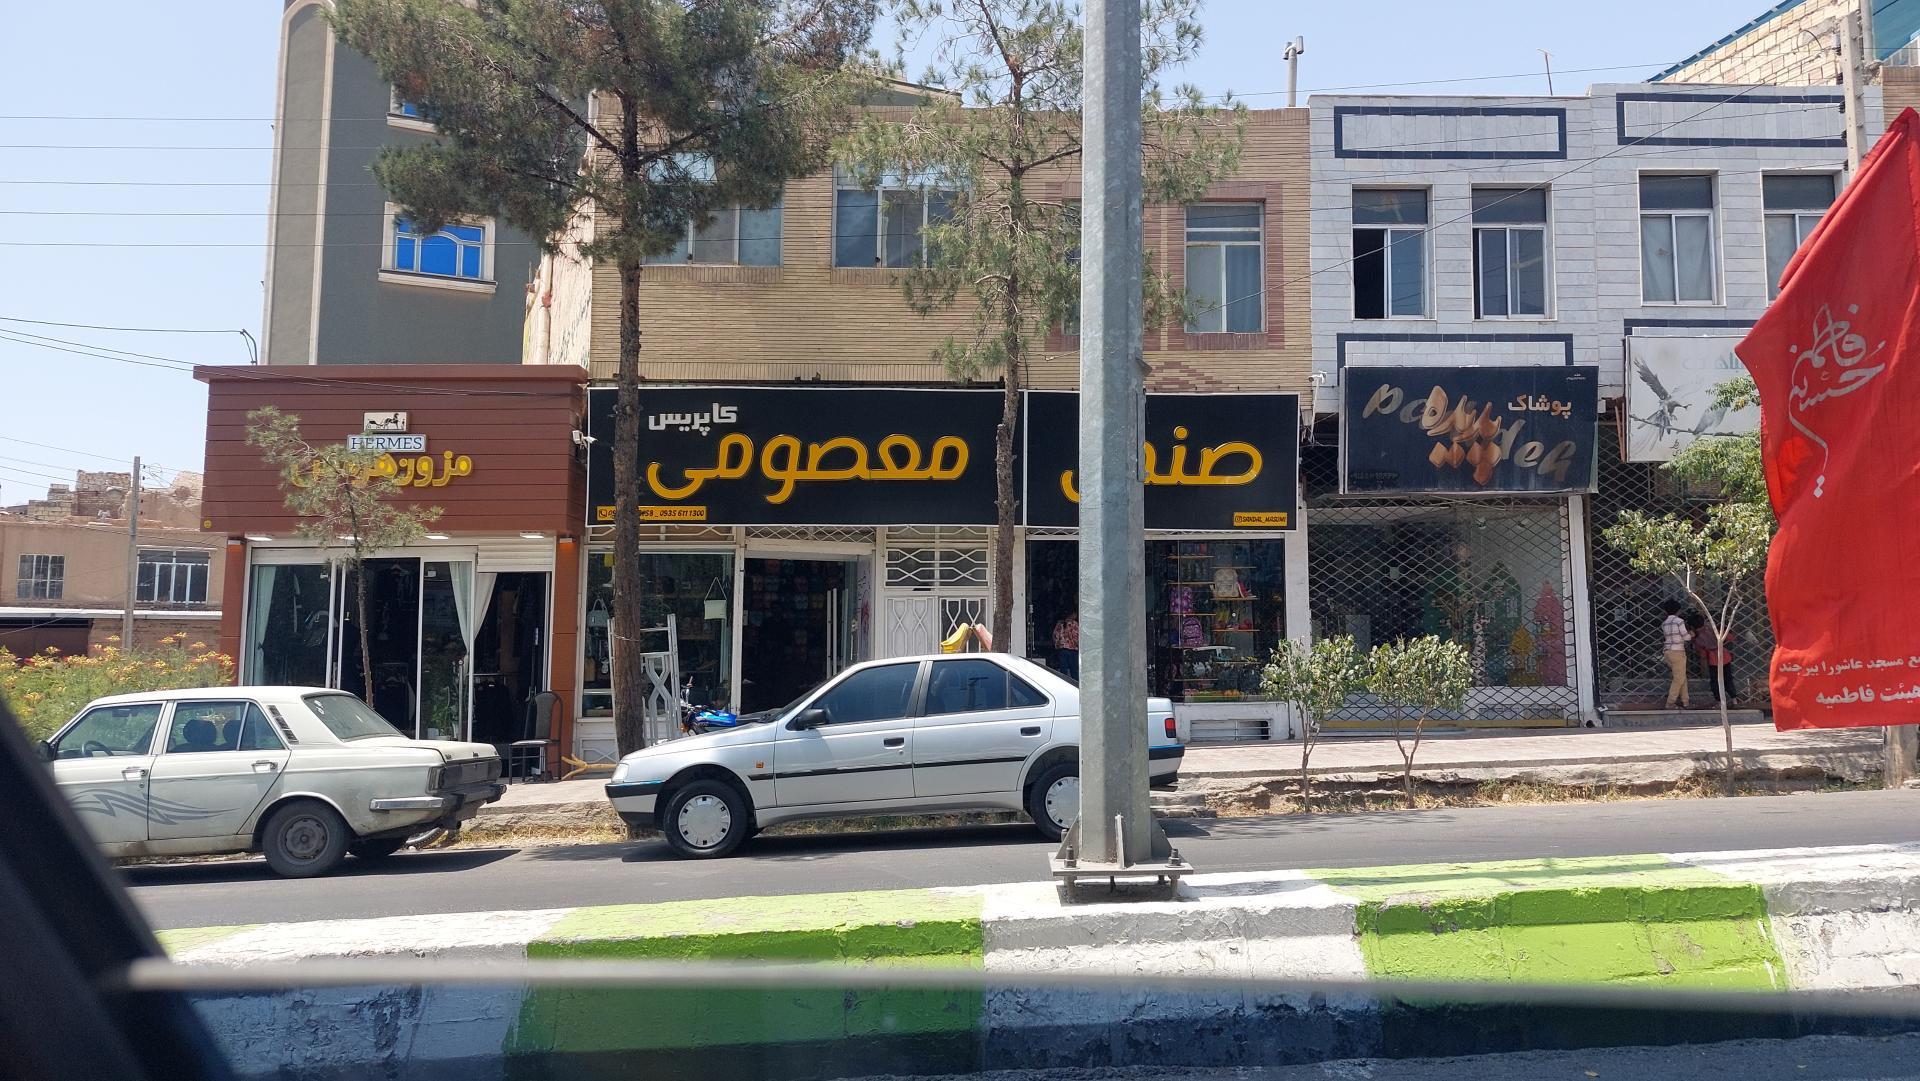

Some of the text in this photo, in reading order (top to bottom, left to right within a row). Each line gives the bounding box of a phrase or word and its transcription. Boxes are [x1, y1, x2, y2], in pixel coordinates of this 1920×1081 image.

[648, 402, 738, 435] کاپریس
[1508, 394, 1572, 419] پوشاک
[351, 437, 422, 450] HERMES
[646, 433, 970, 504] معصومی
[1060, 426, 1263, 503] صن
[1779, 663, 1819, 677] بیرجند
[1866, 658, 1904, 671] مسجد
[1815, 684, 1875, 709] فاطمیه
